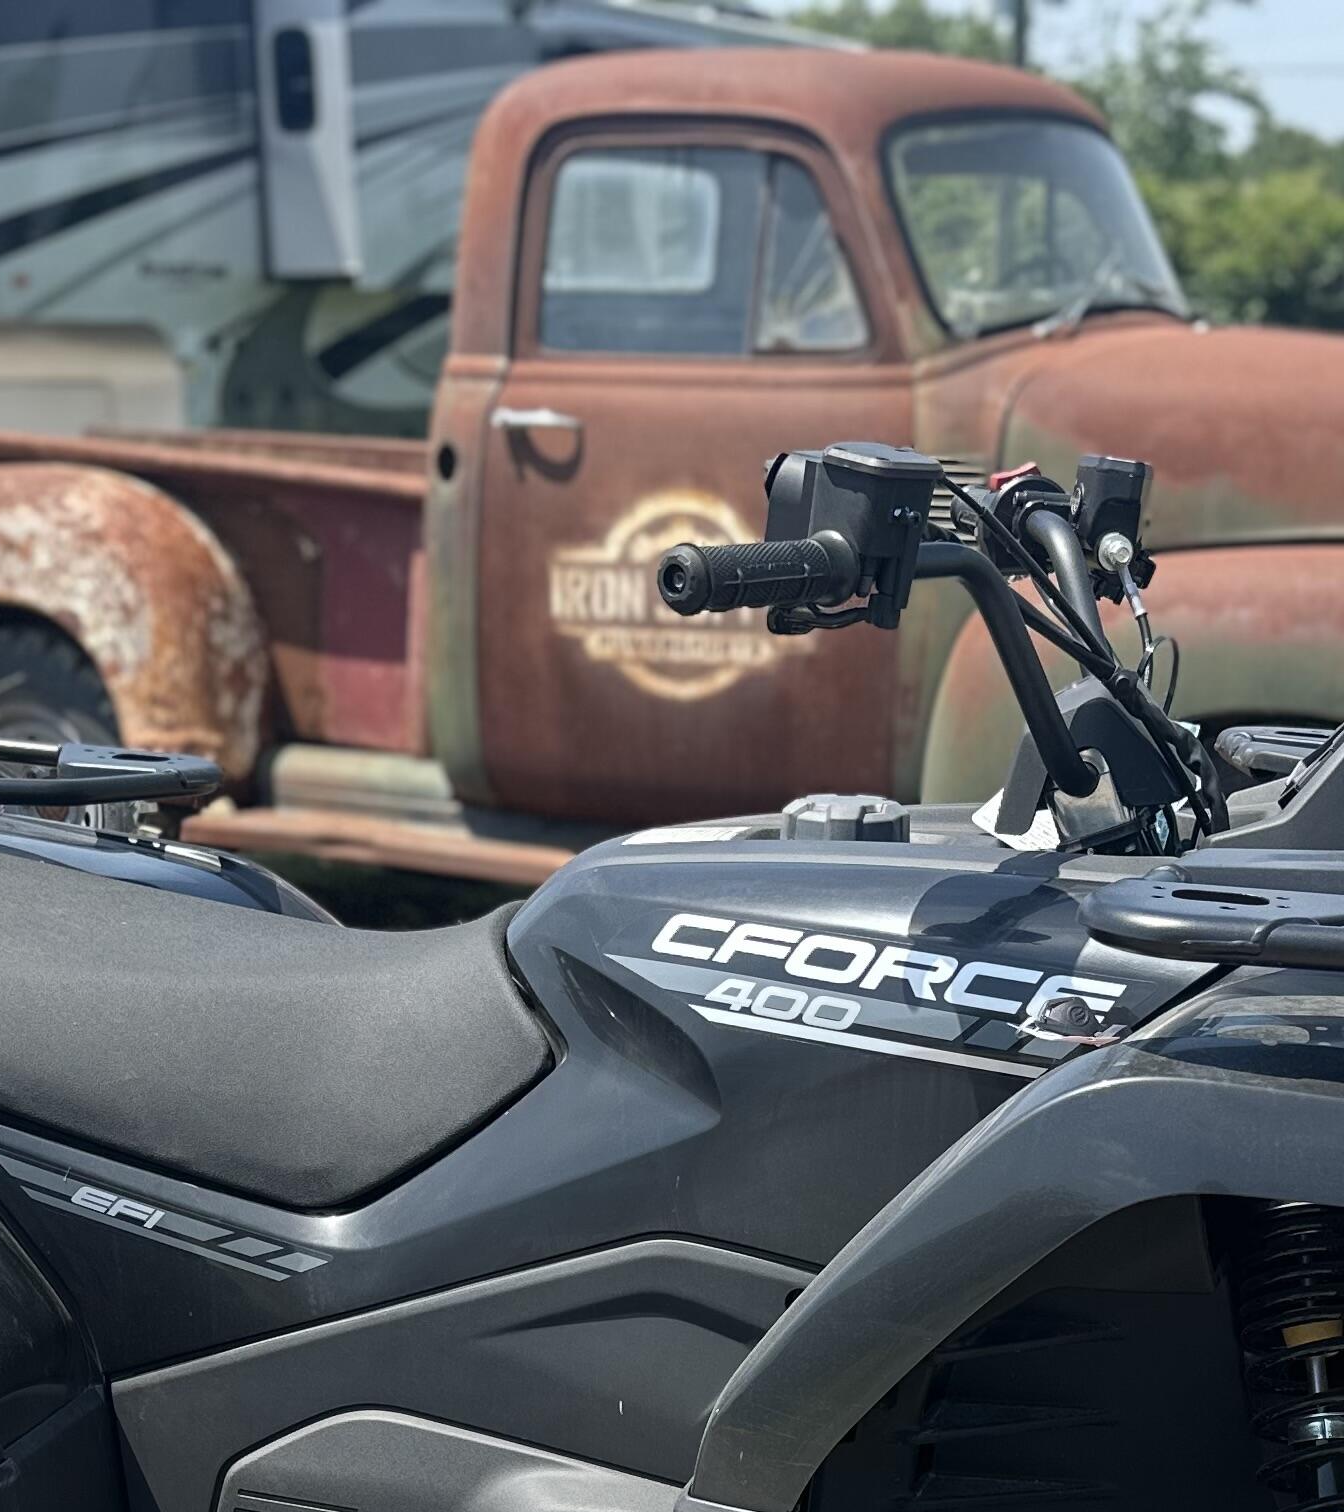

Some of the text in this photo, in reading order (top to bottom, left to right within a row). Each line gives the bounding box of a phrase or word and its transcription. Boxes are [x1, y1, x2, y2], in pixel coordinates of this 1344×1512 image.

[550, 565, 647, 622] IRON
[651, 913, 1128, 1025] CFORCE
[704, 977, 862, 1031] 400
[71, 1186, 166, 1229] EFI
